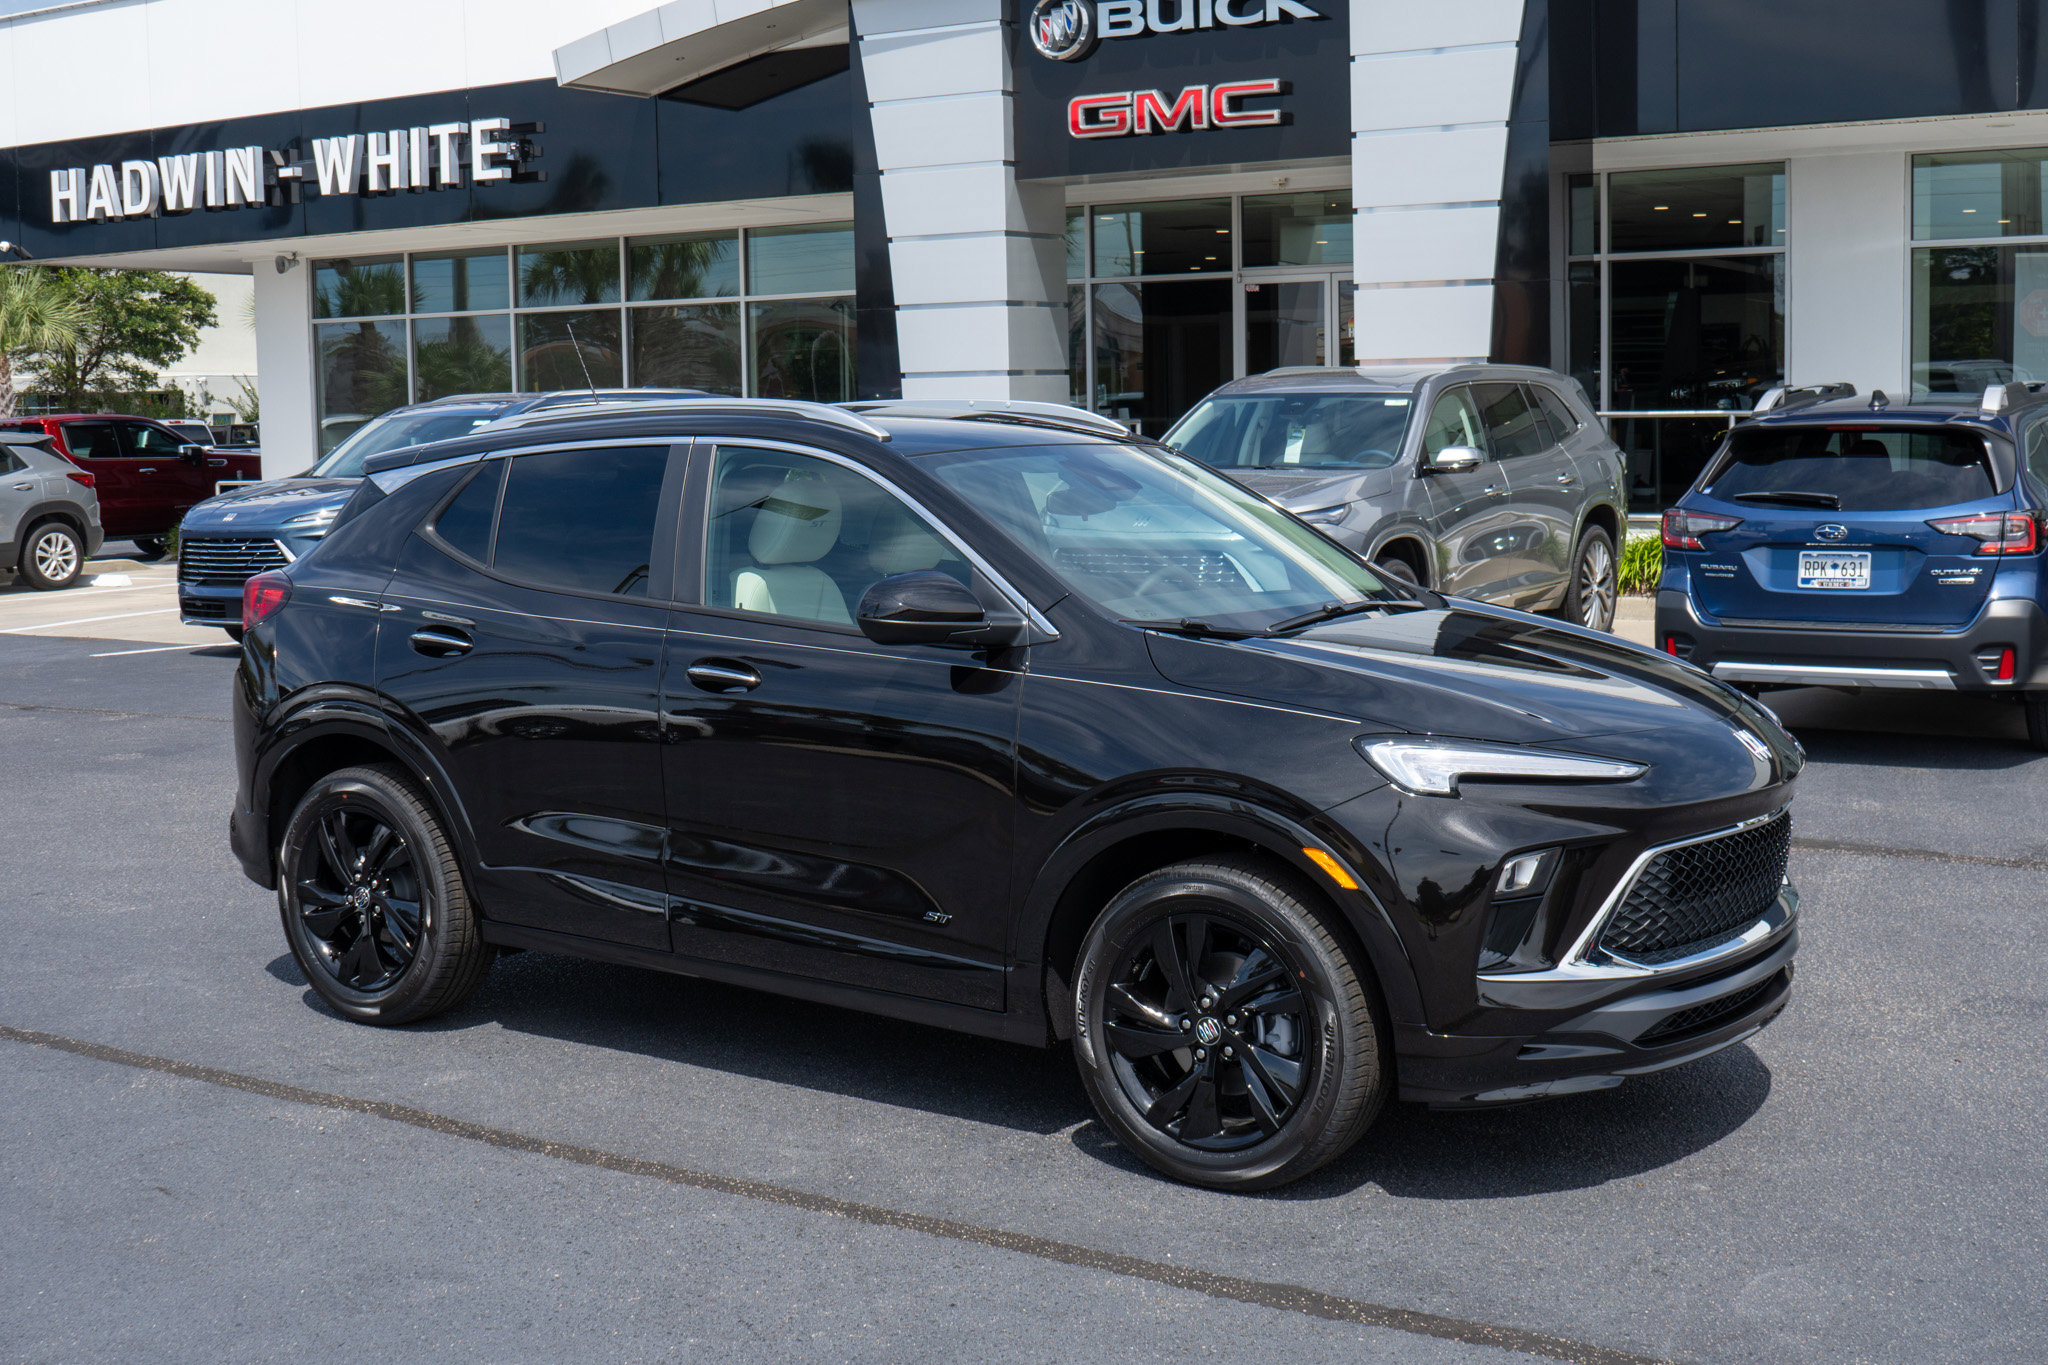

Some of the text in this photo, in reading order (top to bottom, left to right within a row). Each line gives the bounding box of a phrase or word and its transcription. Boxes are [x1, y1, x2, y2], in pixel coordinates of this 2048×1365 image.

[1097, 0, 1319, 39] BUICK
[1067, 78, 1281, 139] GMC
[50, 145, 265, 223] HADWIN
[312, 117, 511, 196] WHITE
[1700, 563, 1738, 571] SUBARU
[1803, 560, 1865, 578] RPK 631
[1930, 567, 1983, 576] OUTBACK
[922, 911, 953, 924] ST
[1077, 972, 1090, 1038] KINERGY
